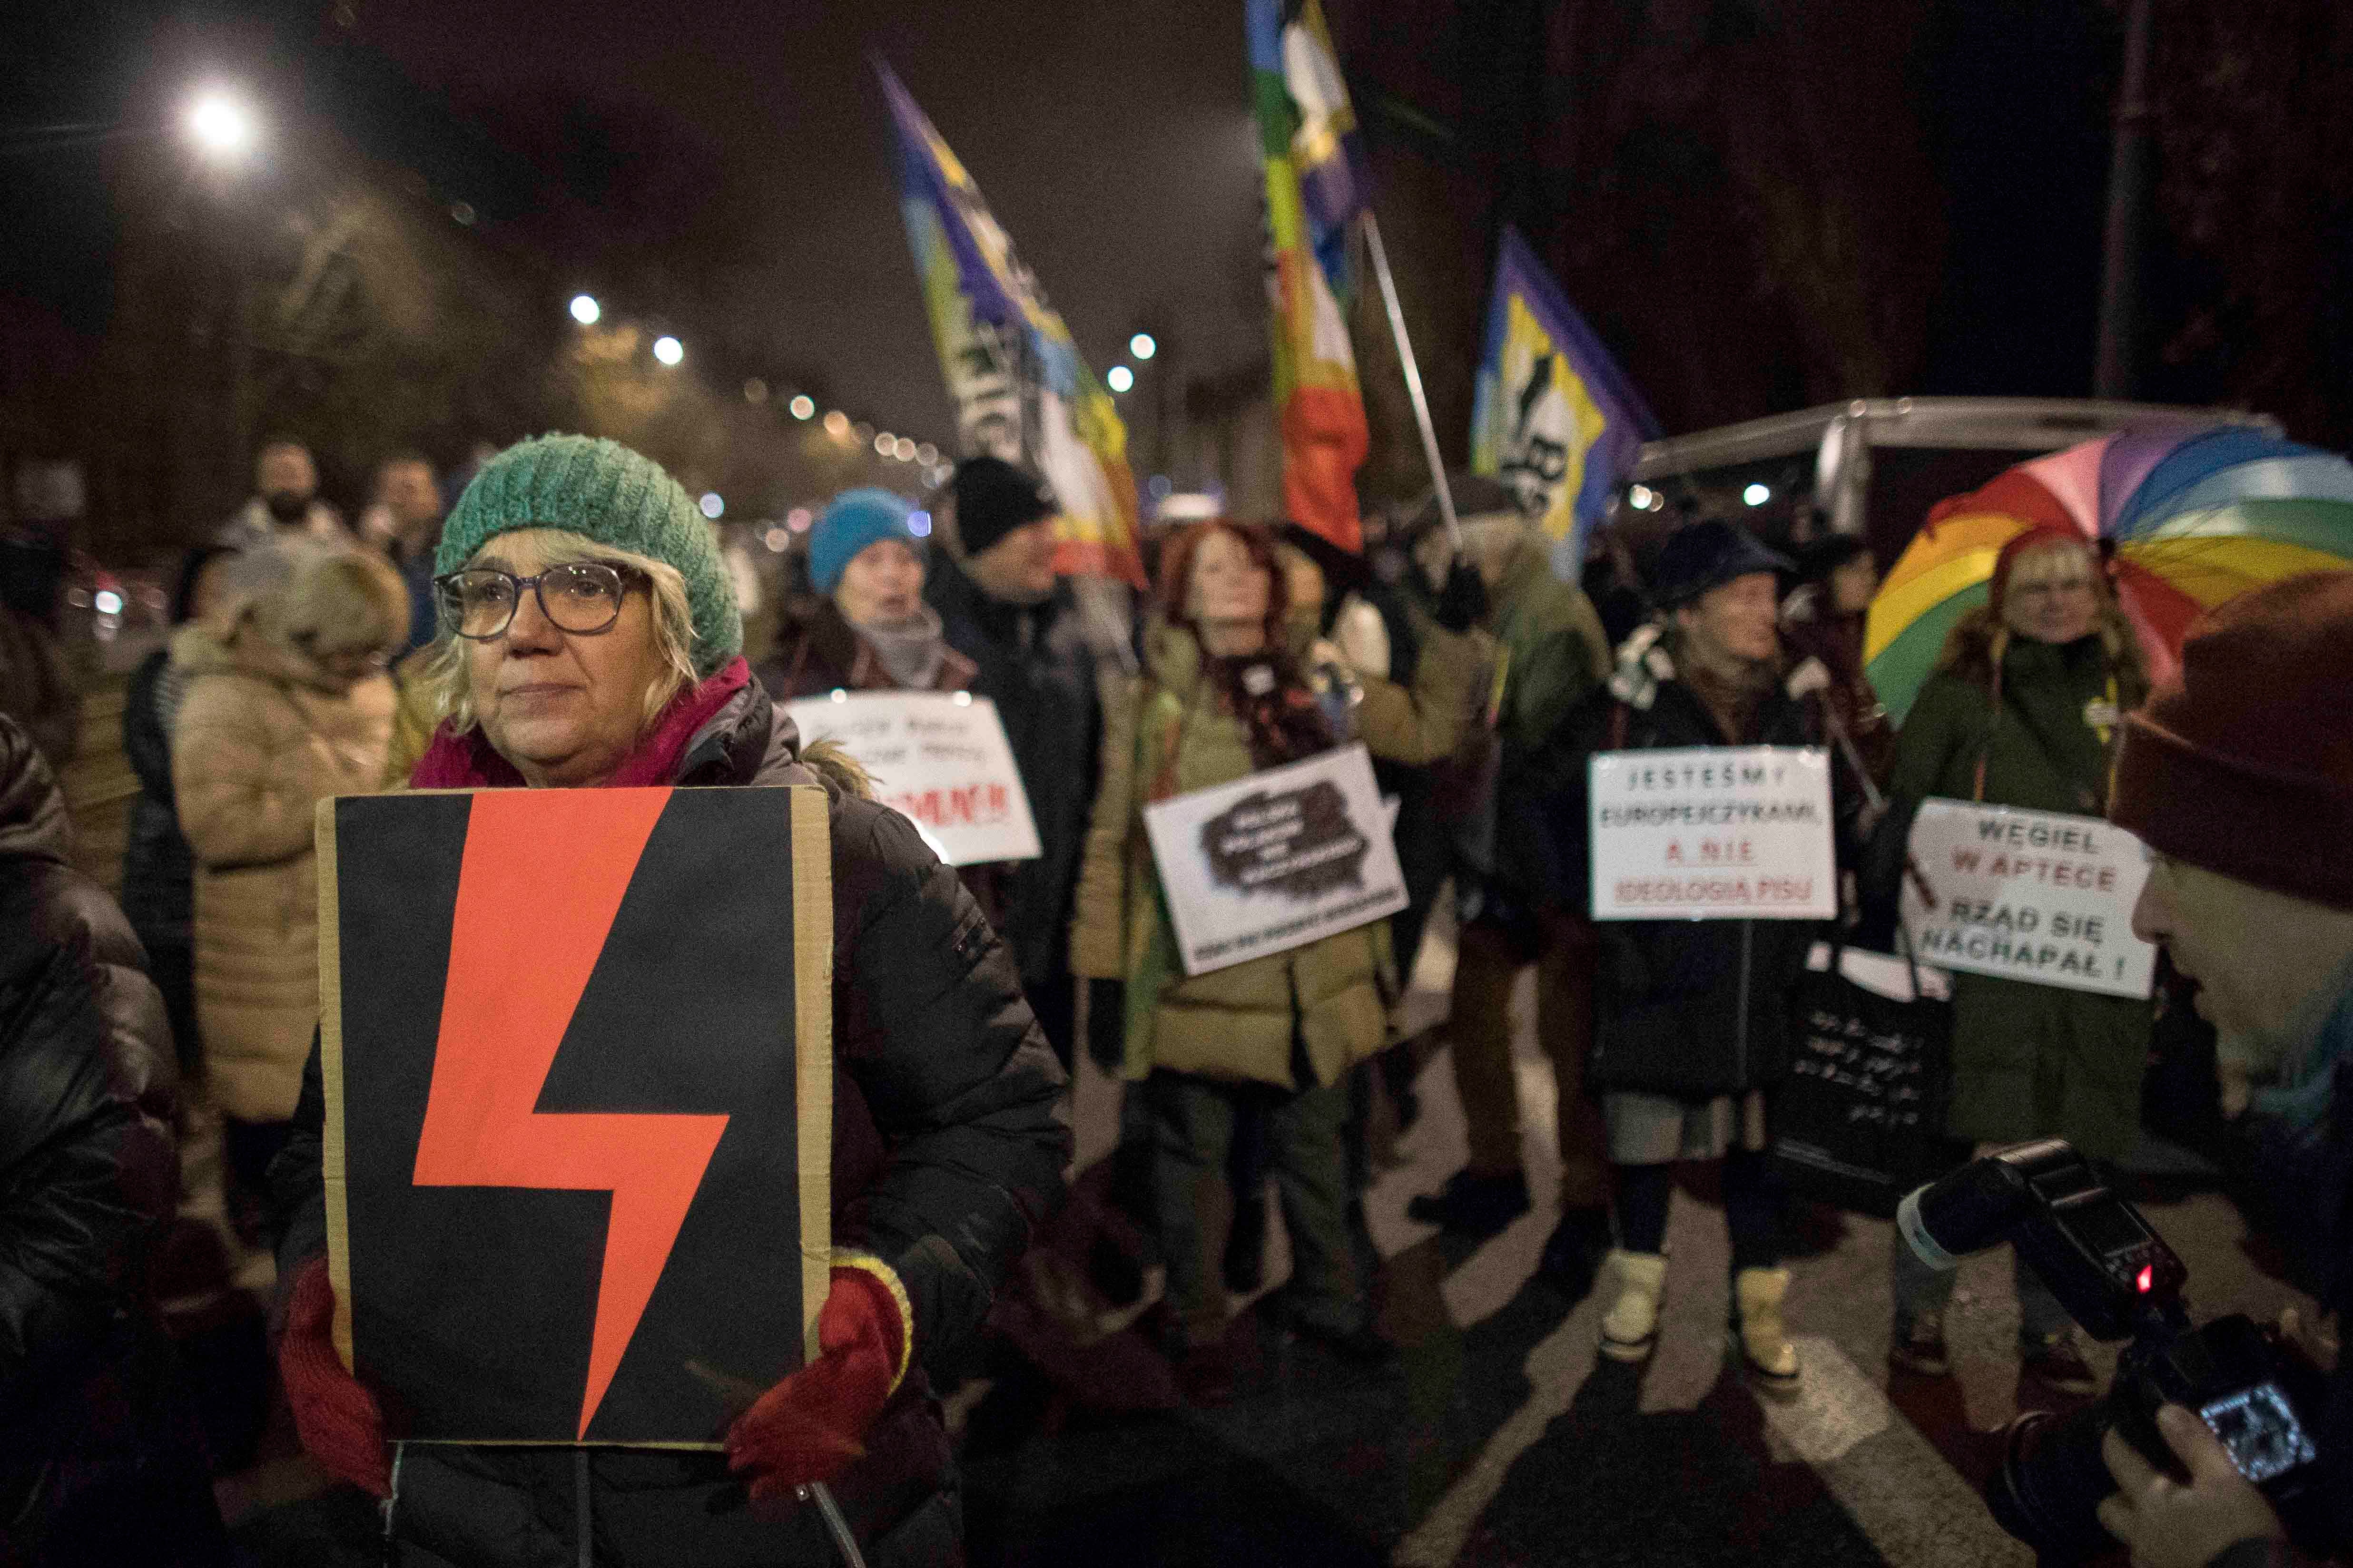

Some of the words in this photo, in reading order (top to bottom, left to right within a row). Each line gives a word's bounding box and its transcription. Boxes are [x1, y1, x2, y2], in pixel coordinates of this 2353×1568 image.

[1667, 840, 1683, 861] A
[1700, 839, 1752, 862] NIE
[1953, 850, 1980, 872] W
[1991, 855, 2116, 890] APTECE
